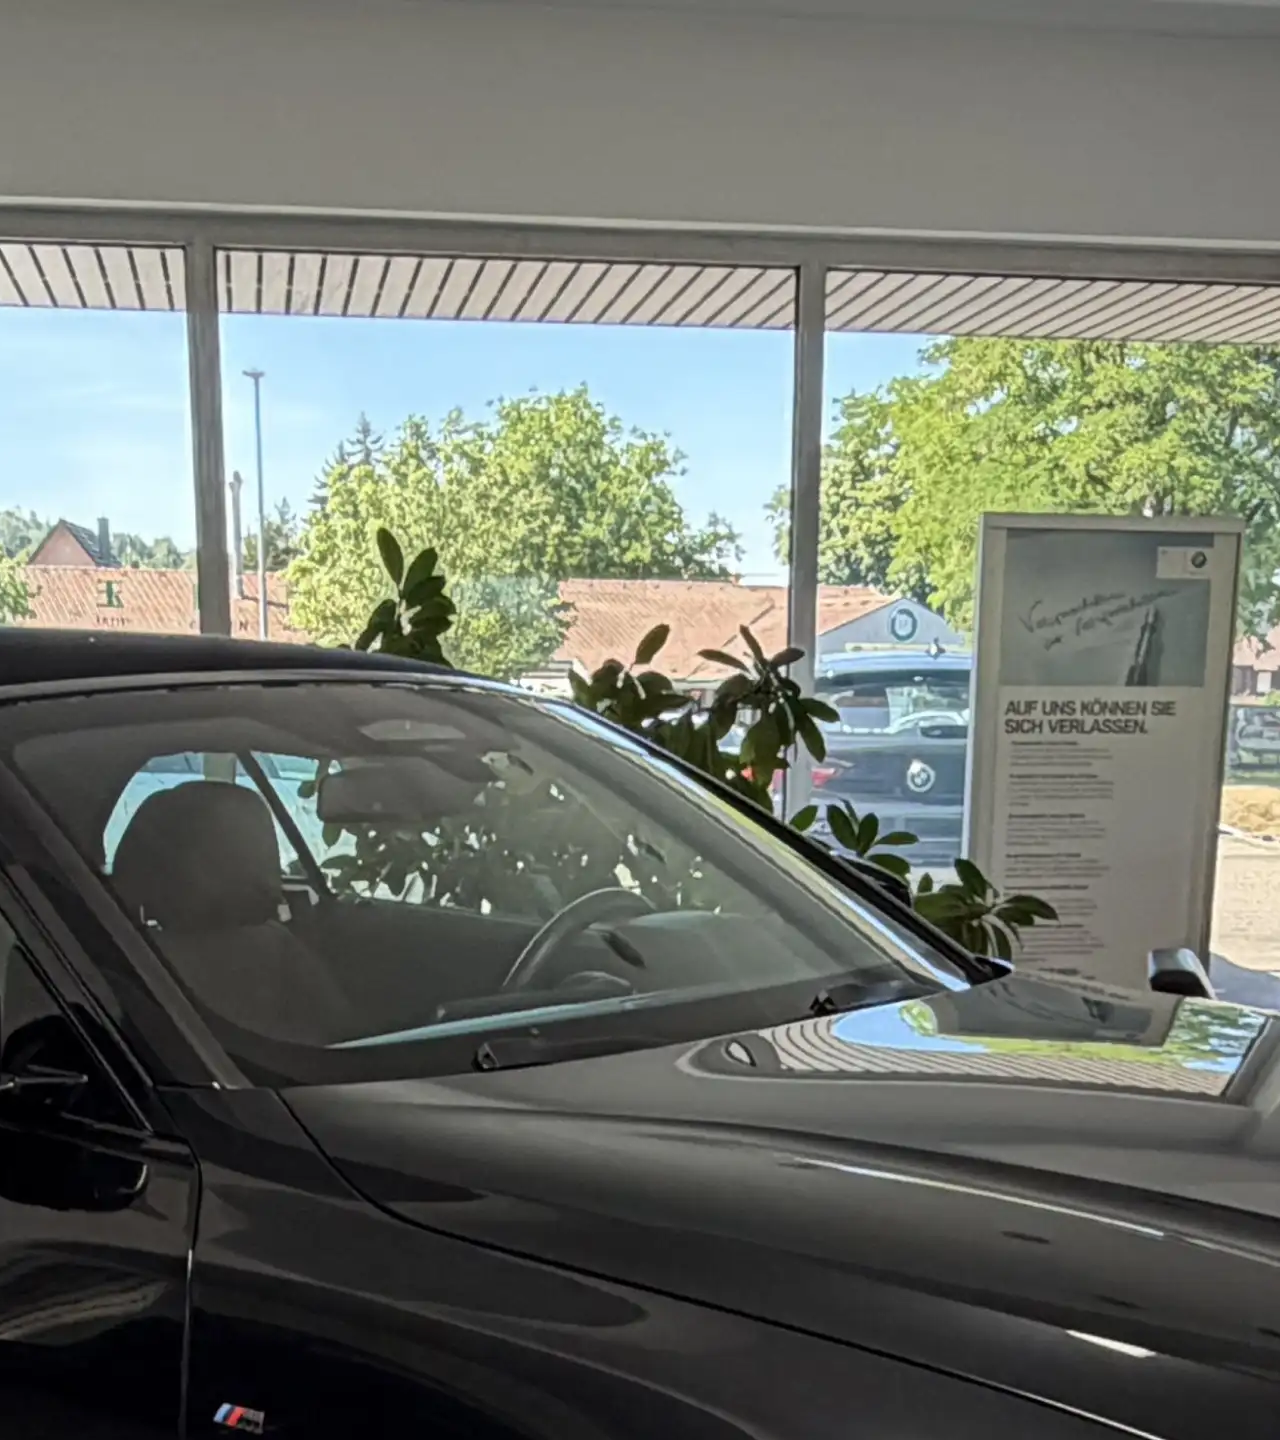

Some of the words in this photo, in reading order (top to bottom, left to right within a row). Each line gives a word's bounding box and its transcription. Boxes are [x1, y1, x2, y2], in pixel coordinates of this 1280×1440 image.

[1004, 700, 1039, 716] AUF
[1041, 700, 1077, 717] UNS
[1079, 696, 1147, 717] KÖNNEN
[1150, 700, 1177, 717] SIE
[1004, 718, 1044, 735] SICH
[1048, 718, 1149, 735] VERLASSEN.
